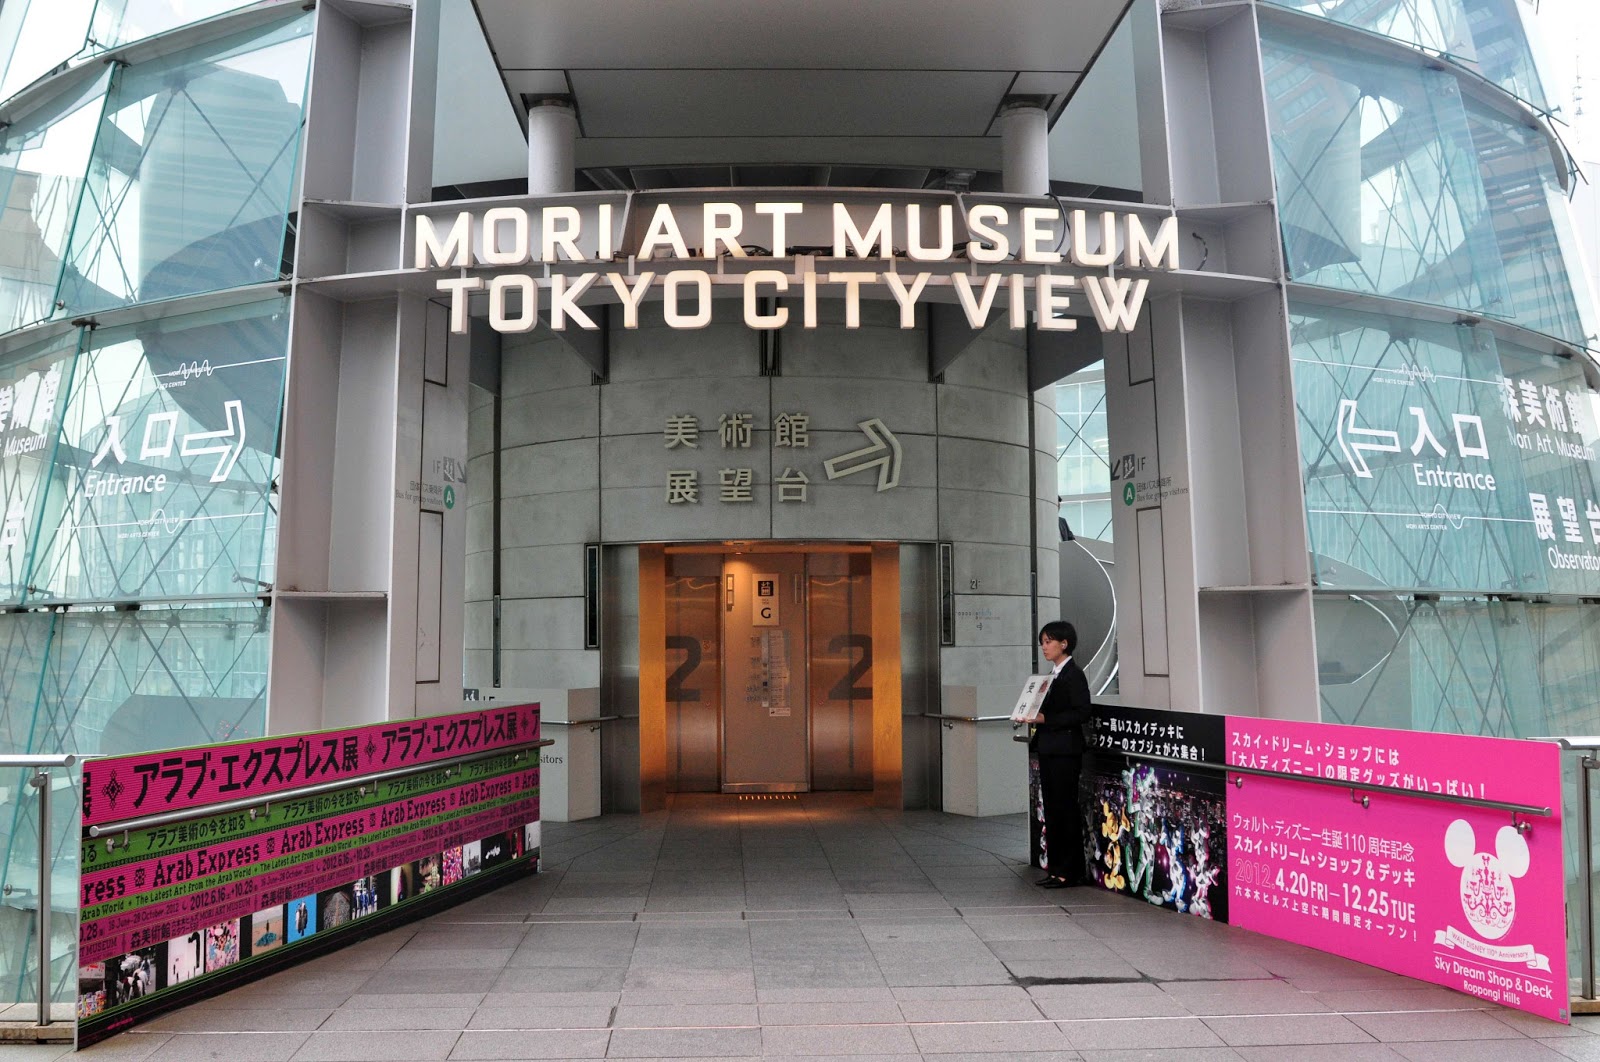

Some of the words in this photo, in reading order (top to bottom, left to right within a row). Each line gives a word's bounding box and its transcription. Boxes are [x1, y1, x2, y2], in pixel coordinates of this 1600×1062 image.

[415, 203, 614, 269] MORI
[637, 202, 803, 260] ART
[833, 202, 1179, 271] MUSEUM
[436, 270, 712, 334] TOKYO
[744, 270, 931, 329] CITY
[951, 272, 1149, 333] VIEW
[1496, 374, 1586, 435] 森美術館
[3, 433, 47, 458] Museum
[92, 410, 179, 467] 入口
[663, 412, 810, 450] 美術館
[1410, 406, 1490, 460] 入口
[1537, 433, 1553, 454] Art
[1555, 437, 1596, 462] Museum
[84, 472, 166, 499] Entrance
[663, 467, 809, 504] 展望台
[1126, 487, 1133, 501] A
[1414, 463, 1496, 492] Entrance
[445, 490, 452, 504] A
[1529, 492, 1600, 546] 展望台
[1548, 544, 1600, 570] Observato
[761, 607, 771, 619] G
[665, 636, 701, 702] 2
[828, 634, 873, 701] 2
[133, 734, 357, 809] アラブ・エクスプレス展
[381, 712, 516, 764] アラブ・エクスプレス展
[1088, 734, 1205, 761] ラクターのオブジェが大集合！
[1232, 732, 1399, 766] スカイ・ドリーム・ショップには
[146, 813, 244, 851] アラブ美術の今を知る
[283, 789, 359, 819] アラブ美術の今を知る
[84, 874, 125, 904] ress
[153, 852, 193, 887] Arab
[197, 842, 259, 875] Express
[281, 824, 312, 854] Arab
[315, 817, 363, 844] Express
[380, 802, 404, 827] Arab
[407, 797, 445, 820] Express
[459, 784, 478, 806] Arab
[480, 780, 511, 799] Express
[260, 862, 269, 871] The
[271, 856, 288, 868] Latest
[290, 853, 300, 863] Art
[135, 894, 148, 905] The
[150, 887, 172, 901] Latest
[174, 883, 186, 895] Art
[188, 880, 203, 891] from
[205, 877, 215, 887] the
[217, 871, 232, 883] Arab
[233, 866, 251, 879] World
[81, 906, 100, 920] Arab
[101, 899, 124, 914] World
[1235, 885, 1417, 942] 六本木ヒルズ上空に期間限定オープン！
[130, 921, 170, 949] 森美術館
[1452, 931, 1466, 945] WALT
[1466, 939, 1485, 954] DISNEY
[1499, 948, 1528, 959] Anniversary
[1434, 956, 1451, 974] Sky
[1453, 961, 1485, 982] Dream
[1488, 970, 1513, 991] Shop
[1515, 977, 1523, 992] &
[1525, 980, 1553, 1000] Deck
[1463, 980, 1501, 1002] Roppongi
[1503, 991, 1520, 1005] Hills
